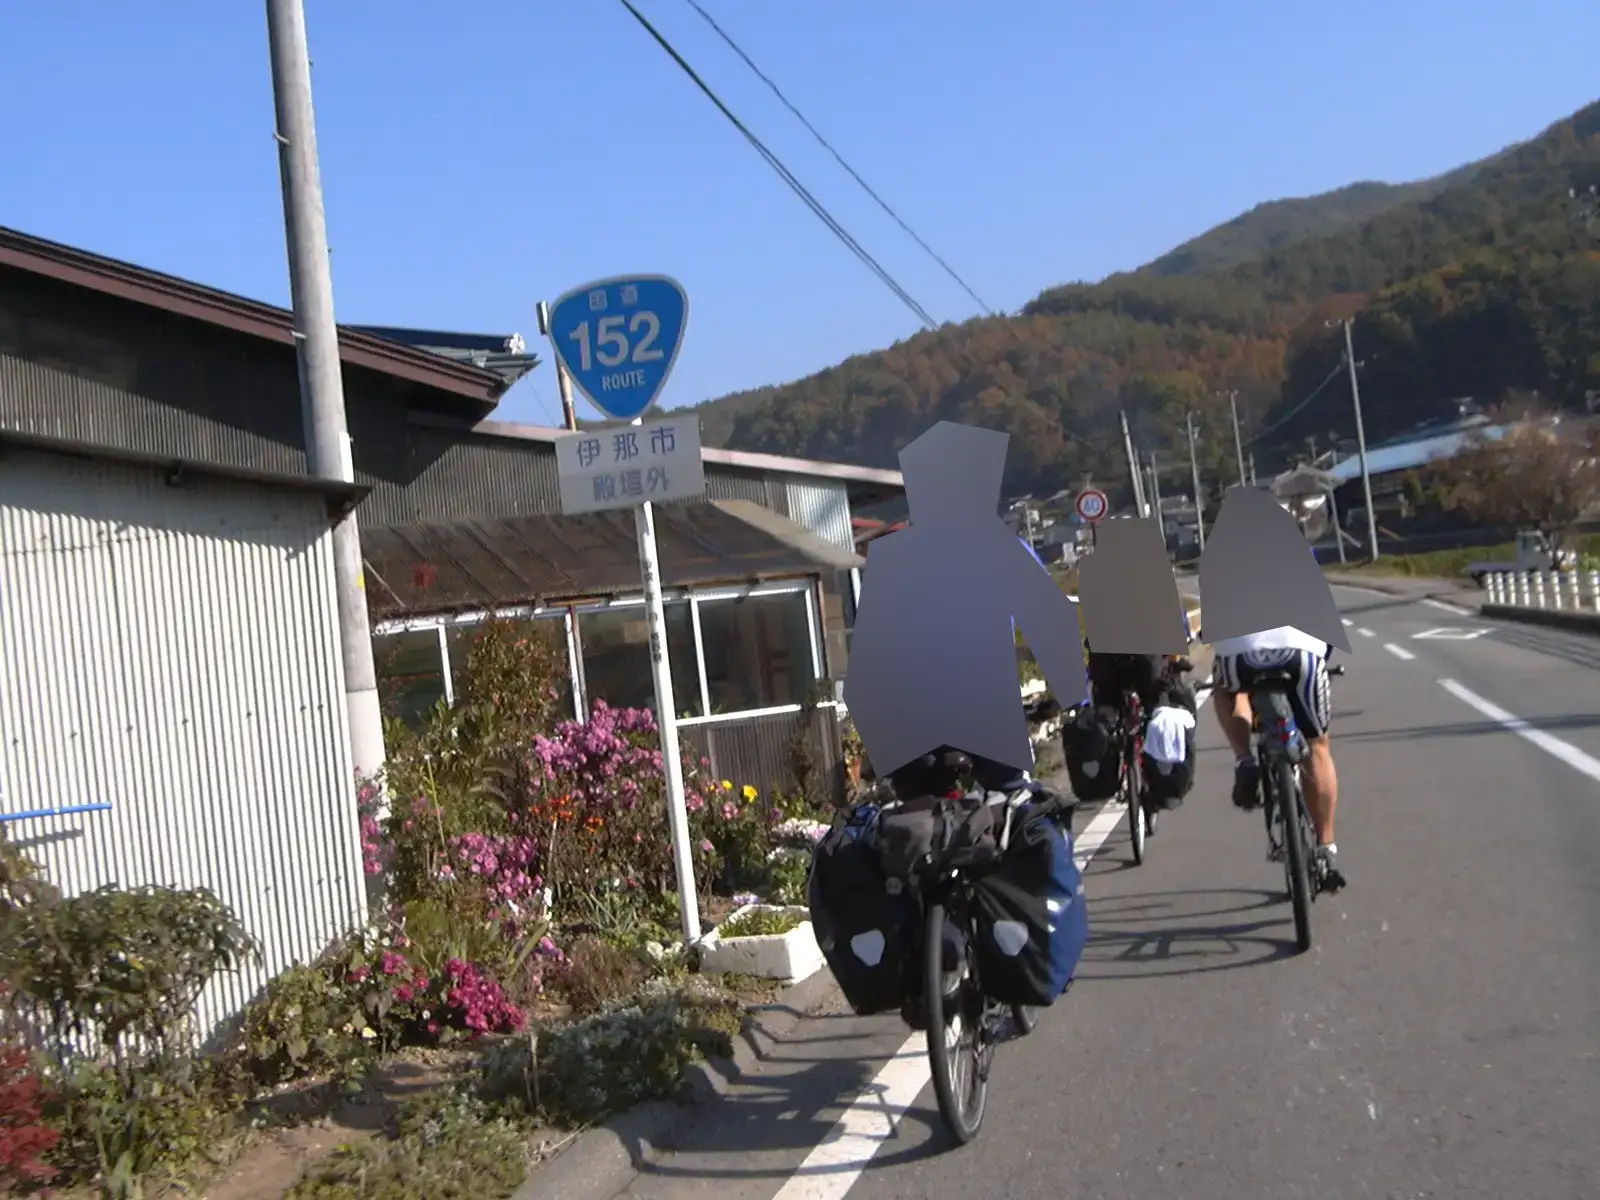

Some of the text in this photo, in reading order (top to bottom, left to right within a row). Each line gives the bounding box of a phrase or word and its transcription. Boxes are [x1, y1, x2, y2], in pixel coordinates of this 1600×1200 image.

[569, 310, 663, 371] 152
[602, 369, 646, 392] ROUTE
[577, 426, 676, 467] 伊那市
[1084, 499, 1100, 512] 40
